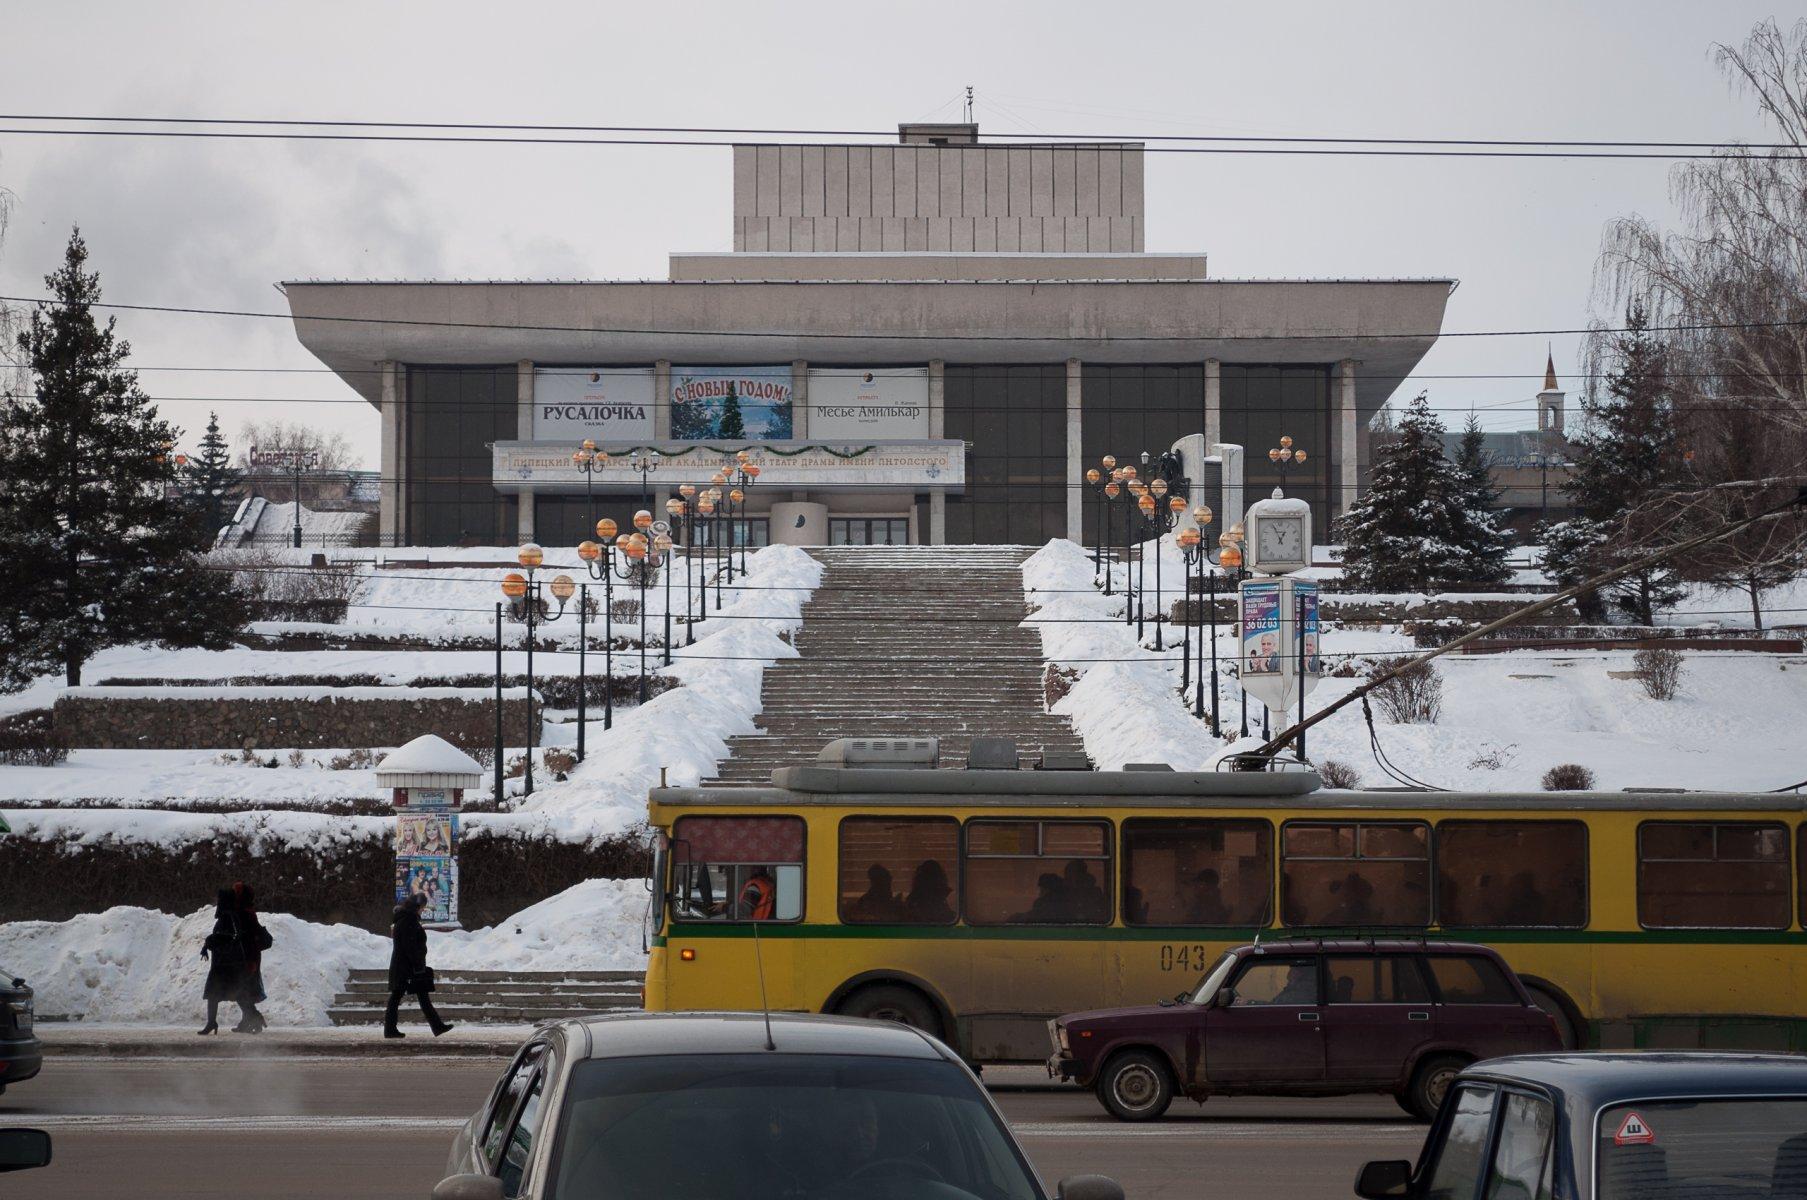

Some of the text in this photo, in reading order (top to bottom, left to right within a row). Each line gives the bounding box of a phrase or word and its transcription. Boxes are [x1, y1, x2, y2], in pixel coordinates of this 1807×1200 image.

[738, 380, 788, 402] ГОДОМ!
[543, 406, 646, 420] РУСАЛОЧКА
[817, 406, 921, 420] Месье Амилькар
[513, 457, 570, 468] ЛИПЕЦКИЙ
[769, 458, 798, 467] ТЕАТР
[801, 457, 835, 467] ДРАМЫ
[839, 457, 875, 466] ИМЕНИ
[1268, 617, 1278, 629] 03
[1161, 944, 1205, 972] 043
[1626, 1124, 1642, 1134] Ш
